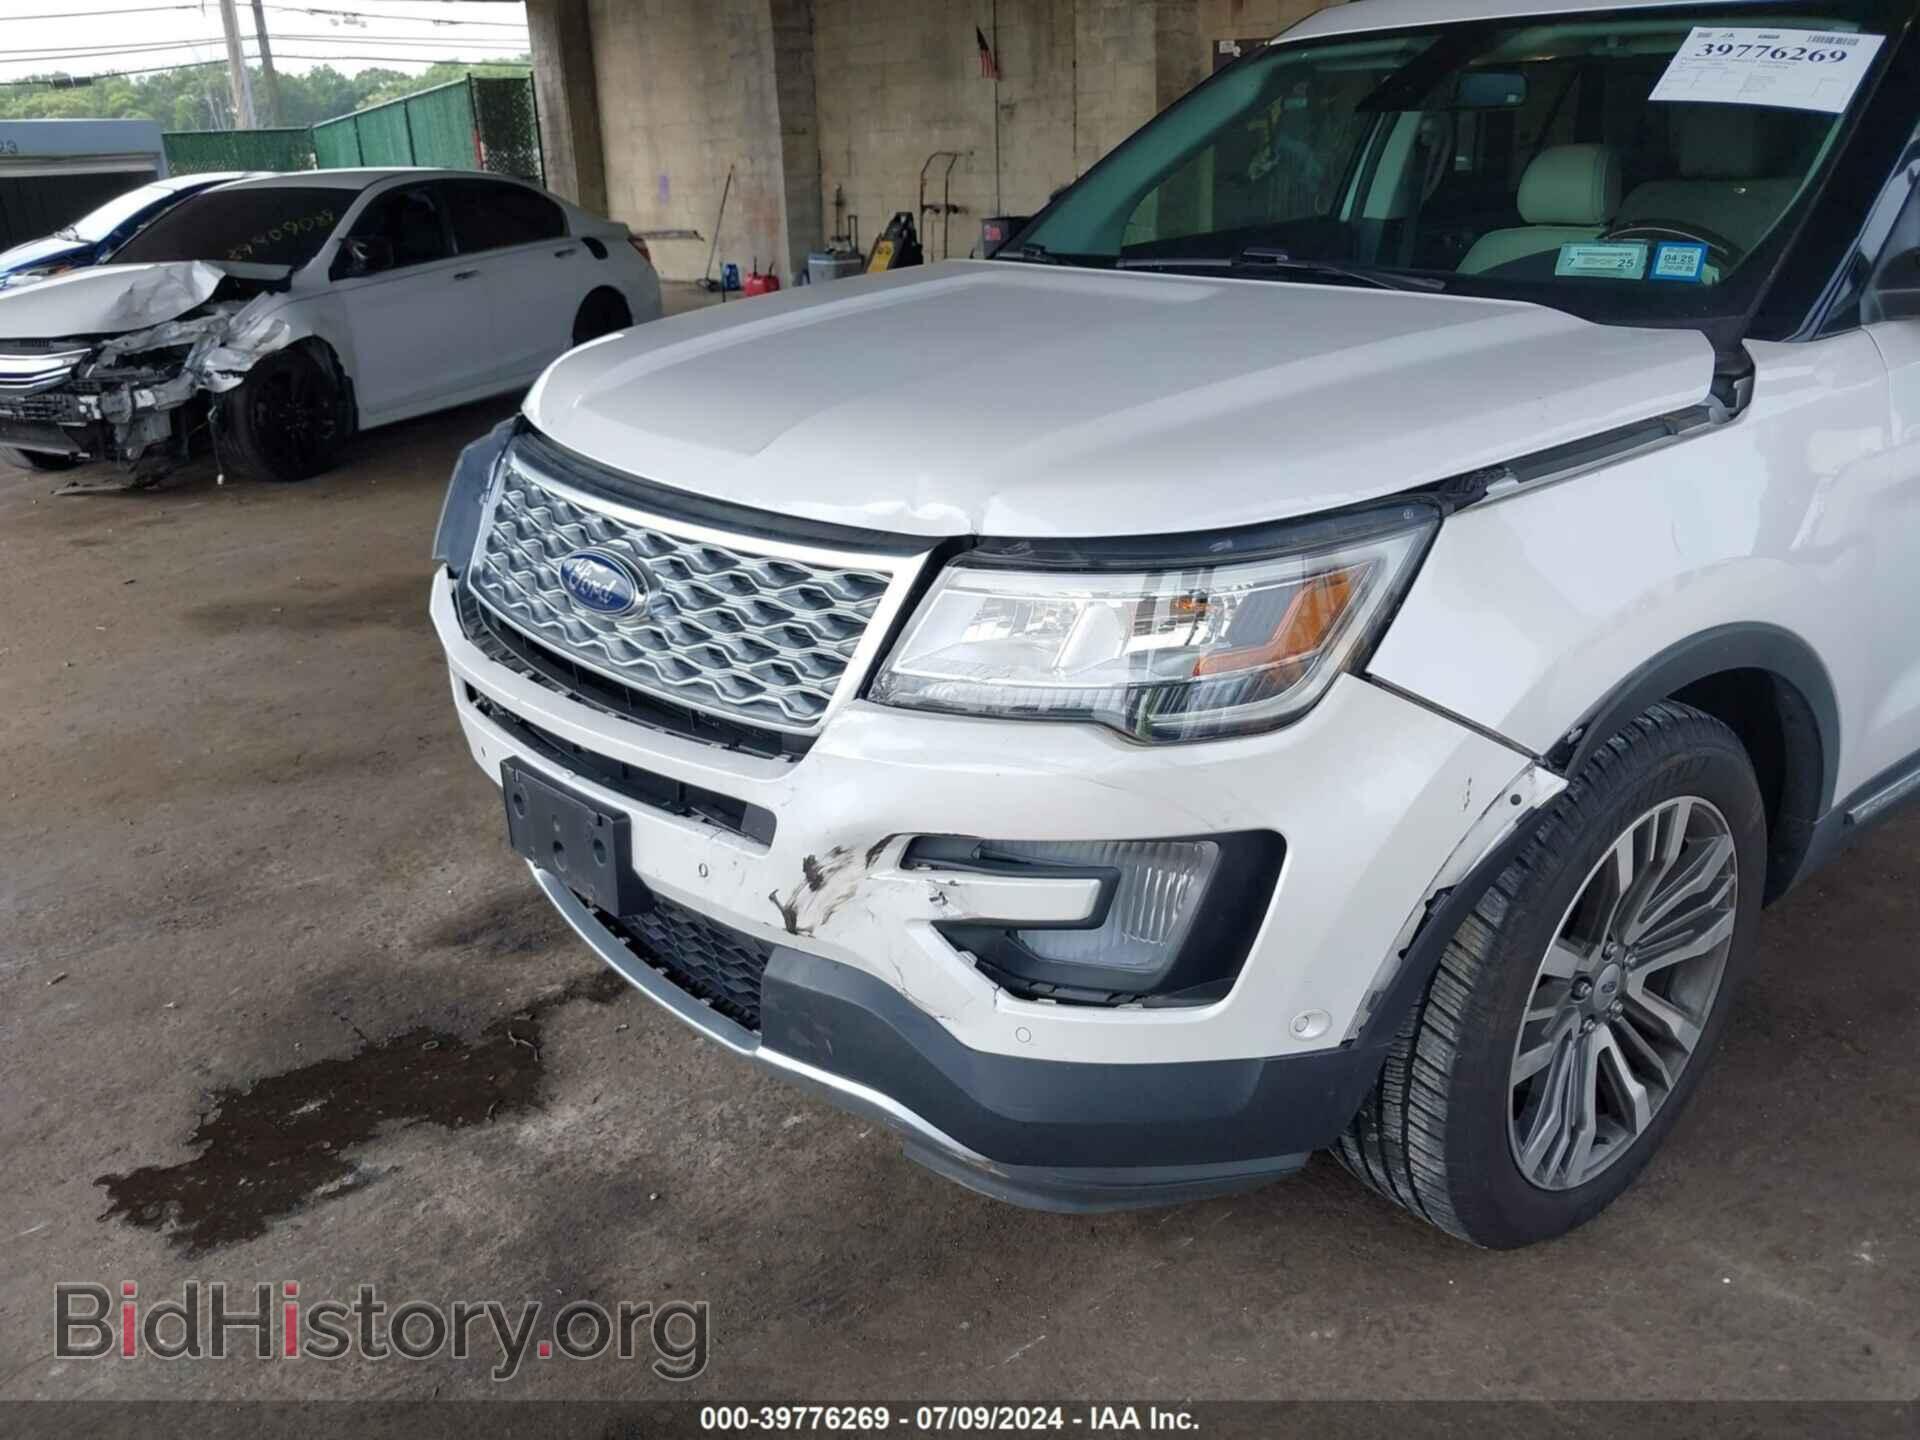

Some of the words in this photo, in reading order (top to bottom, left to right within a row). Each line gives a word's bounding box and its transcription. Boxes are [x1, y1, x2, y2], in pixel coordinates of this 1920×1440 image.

[1694, 43, 1849, 64] 39776269
[1617, 258, 1635, 268] 25
[567, 559, 617, 604] Ford
